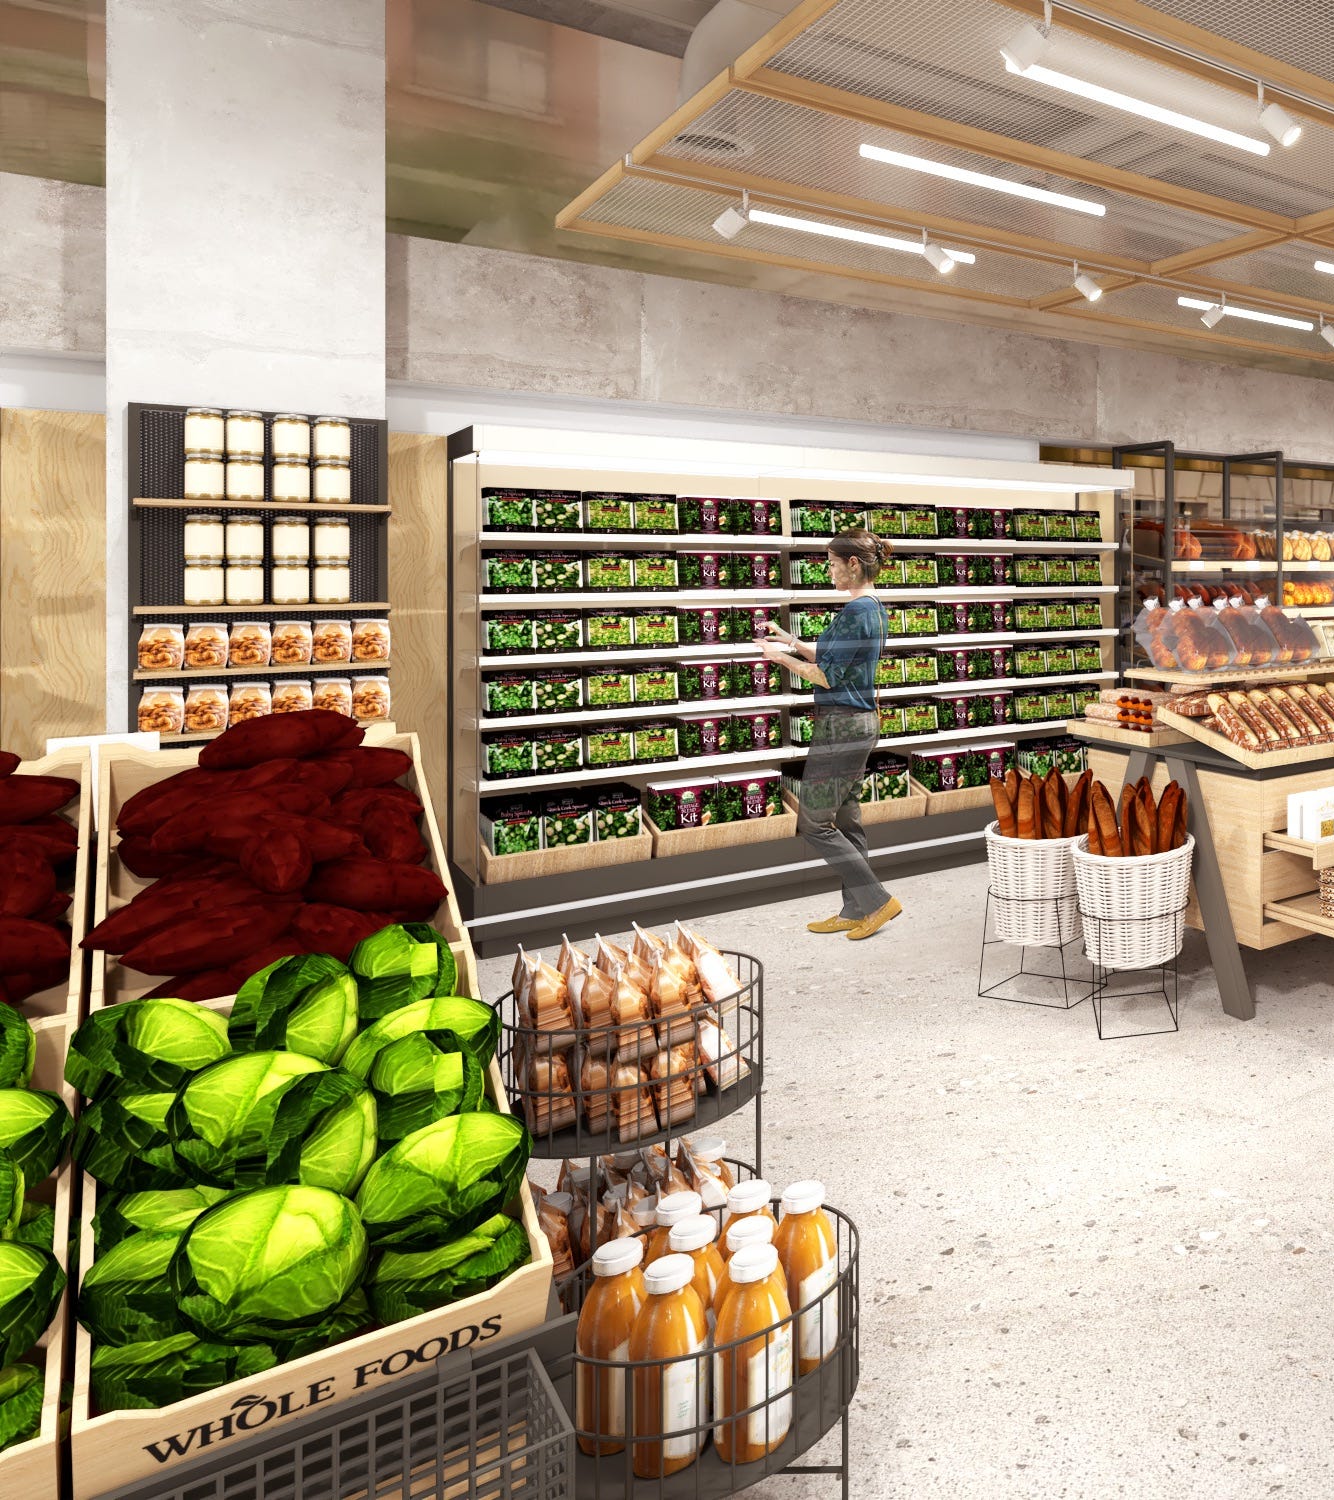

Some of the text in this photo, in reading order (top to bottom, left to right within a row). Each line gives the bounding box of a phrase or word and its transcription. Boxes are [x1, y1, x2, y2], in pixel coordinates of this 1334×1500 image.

[754, 515, 767, 523] Kit
[703, 569, 716, 577] Kit
[754, 569, 767, 577] Kit
[703, 625, 716, 633] Kit
[703, 680, 716, 688] Kit
[754, 677, 767, 685] Kit
[703, 735, 716, 744] Kit
[990, 769, 1003, 778] Kit
[942, 776, 955, 785] Kit
[746, 803, 763, 815] Kit
[680, 813, 698, 824] Kit
[142, 1313, 503, 1463] WHOLE FOODS
